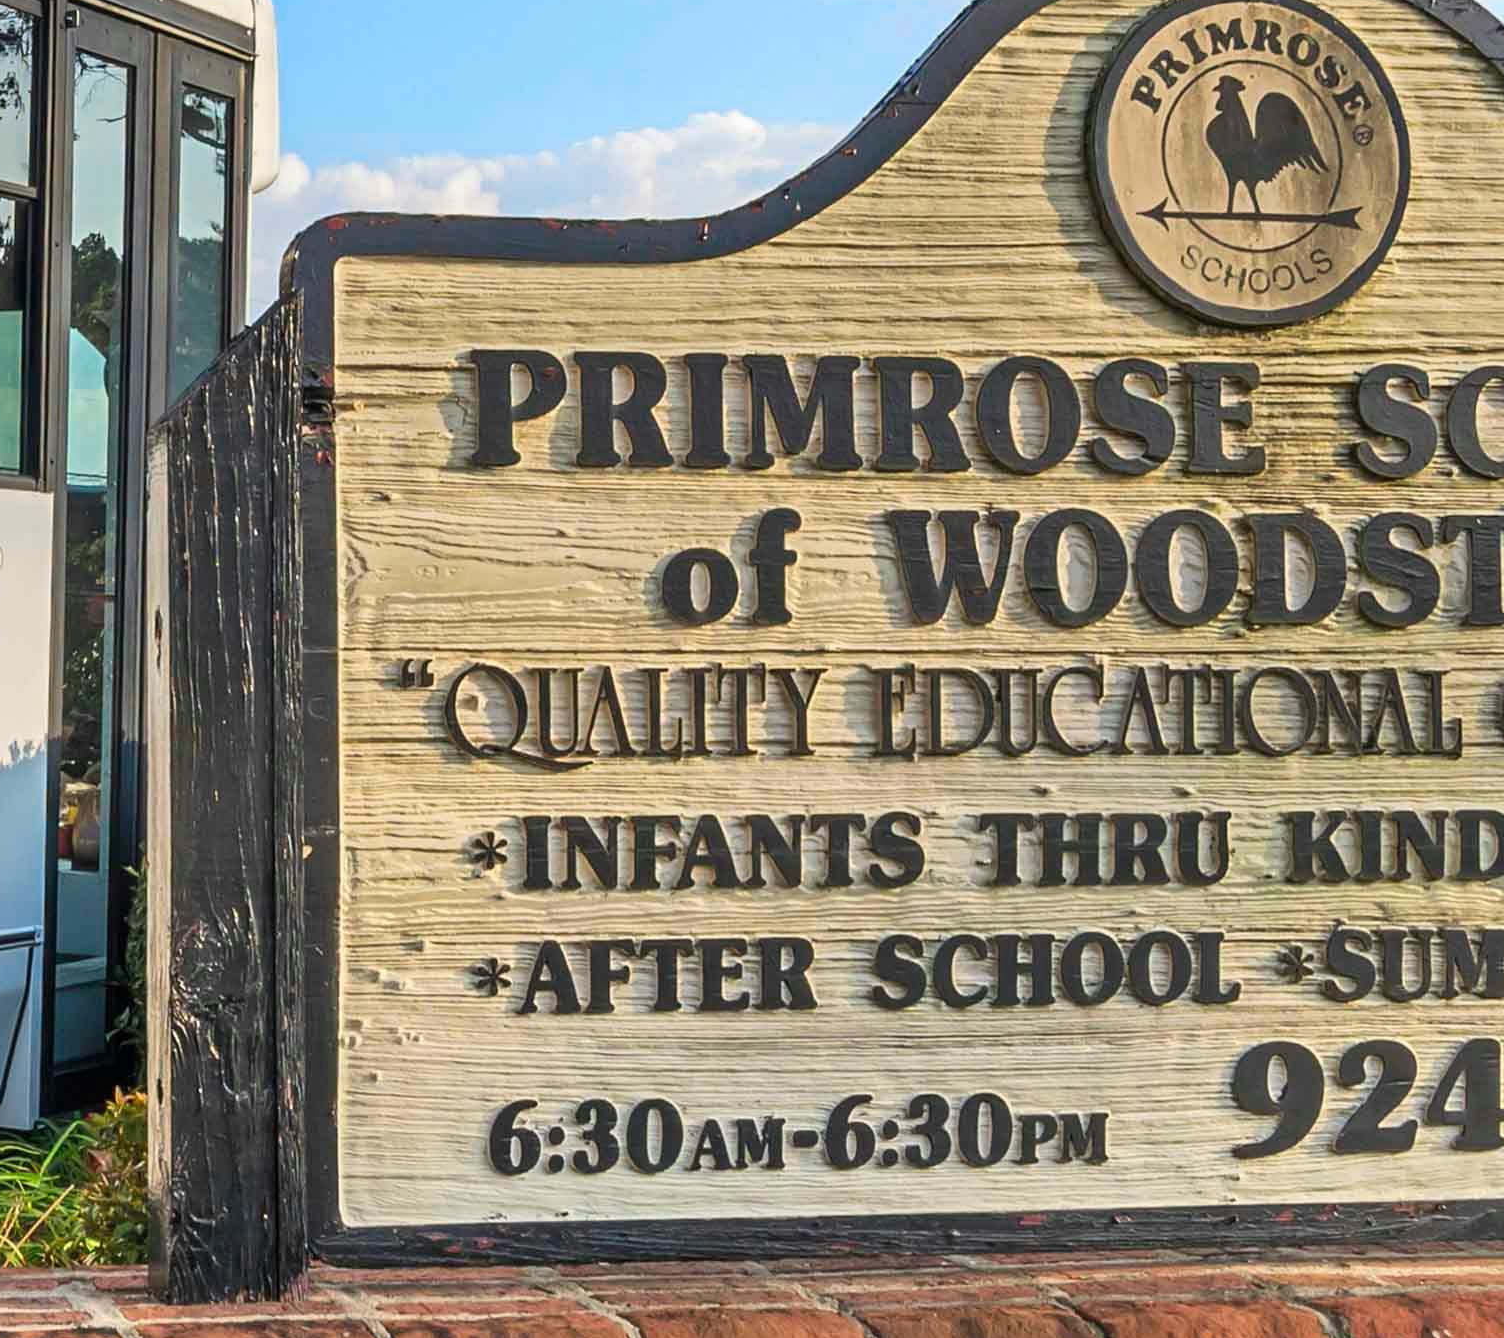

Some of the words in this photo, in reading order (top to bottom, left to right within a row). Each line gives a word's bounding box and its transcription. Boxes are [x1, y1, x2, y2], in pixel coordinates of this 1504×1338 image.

[1179, 243, 1334, 295] SCHOOLS
[470, 348, 1267, 477] PRIMROSE
[661, 507, 803, 628] of
[873, 661, 1464, 759] EDUCATIONAL
[978, 809, 1234, 890] THRU
[870, 927, 1242, 1009] SCHOOL
[486, 1092, 1111, 1176] 6:30AM-6:30PM
